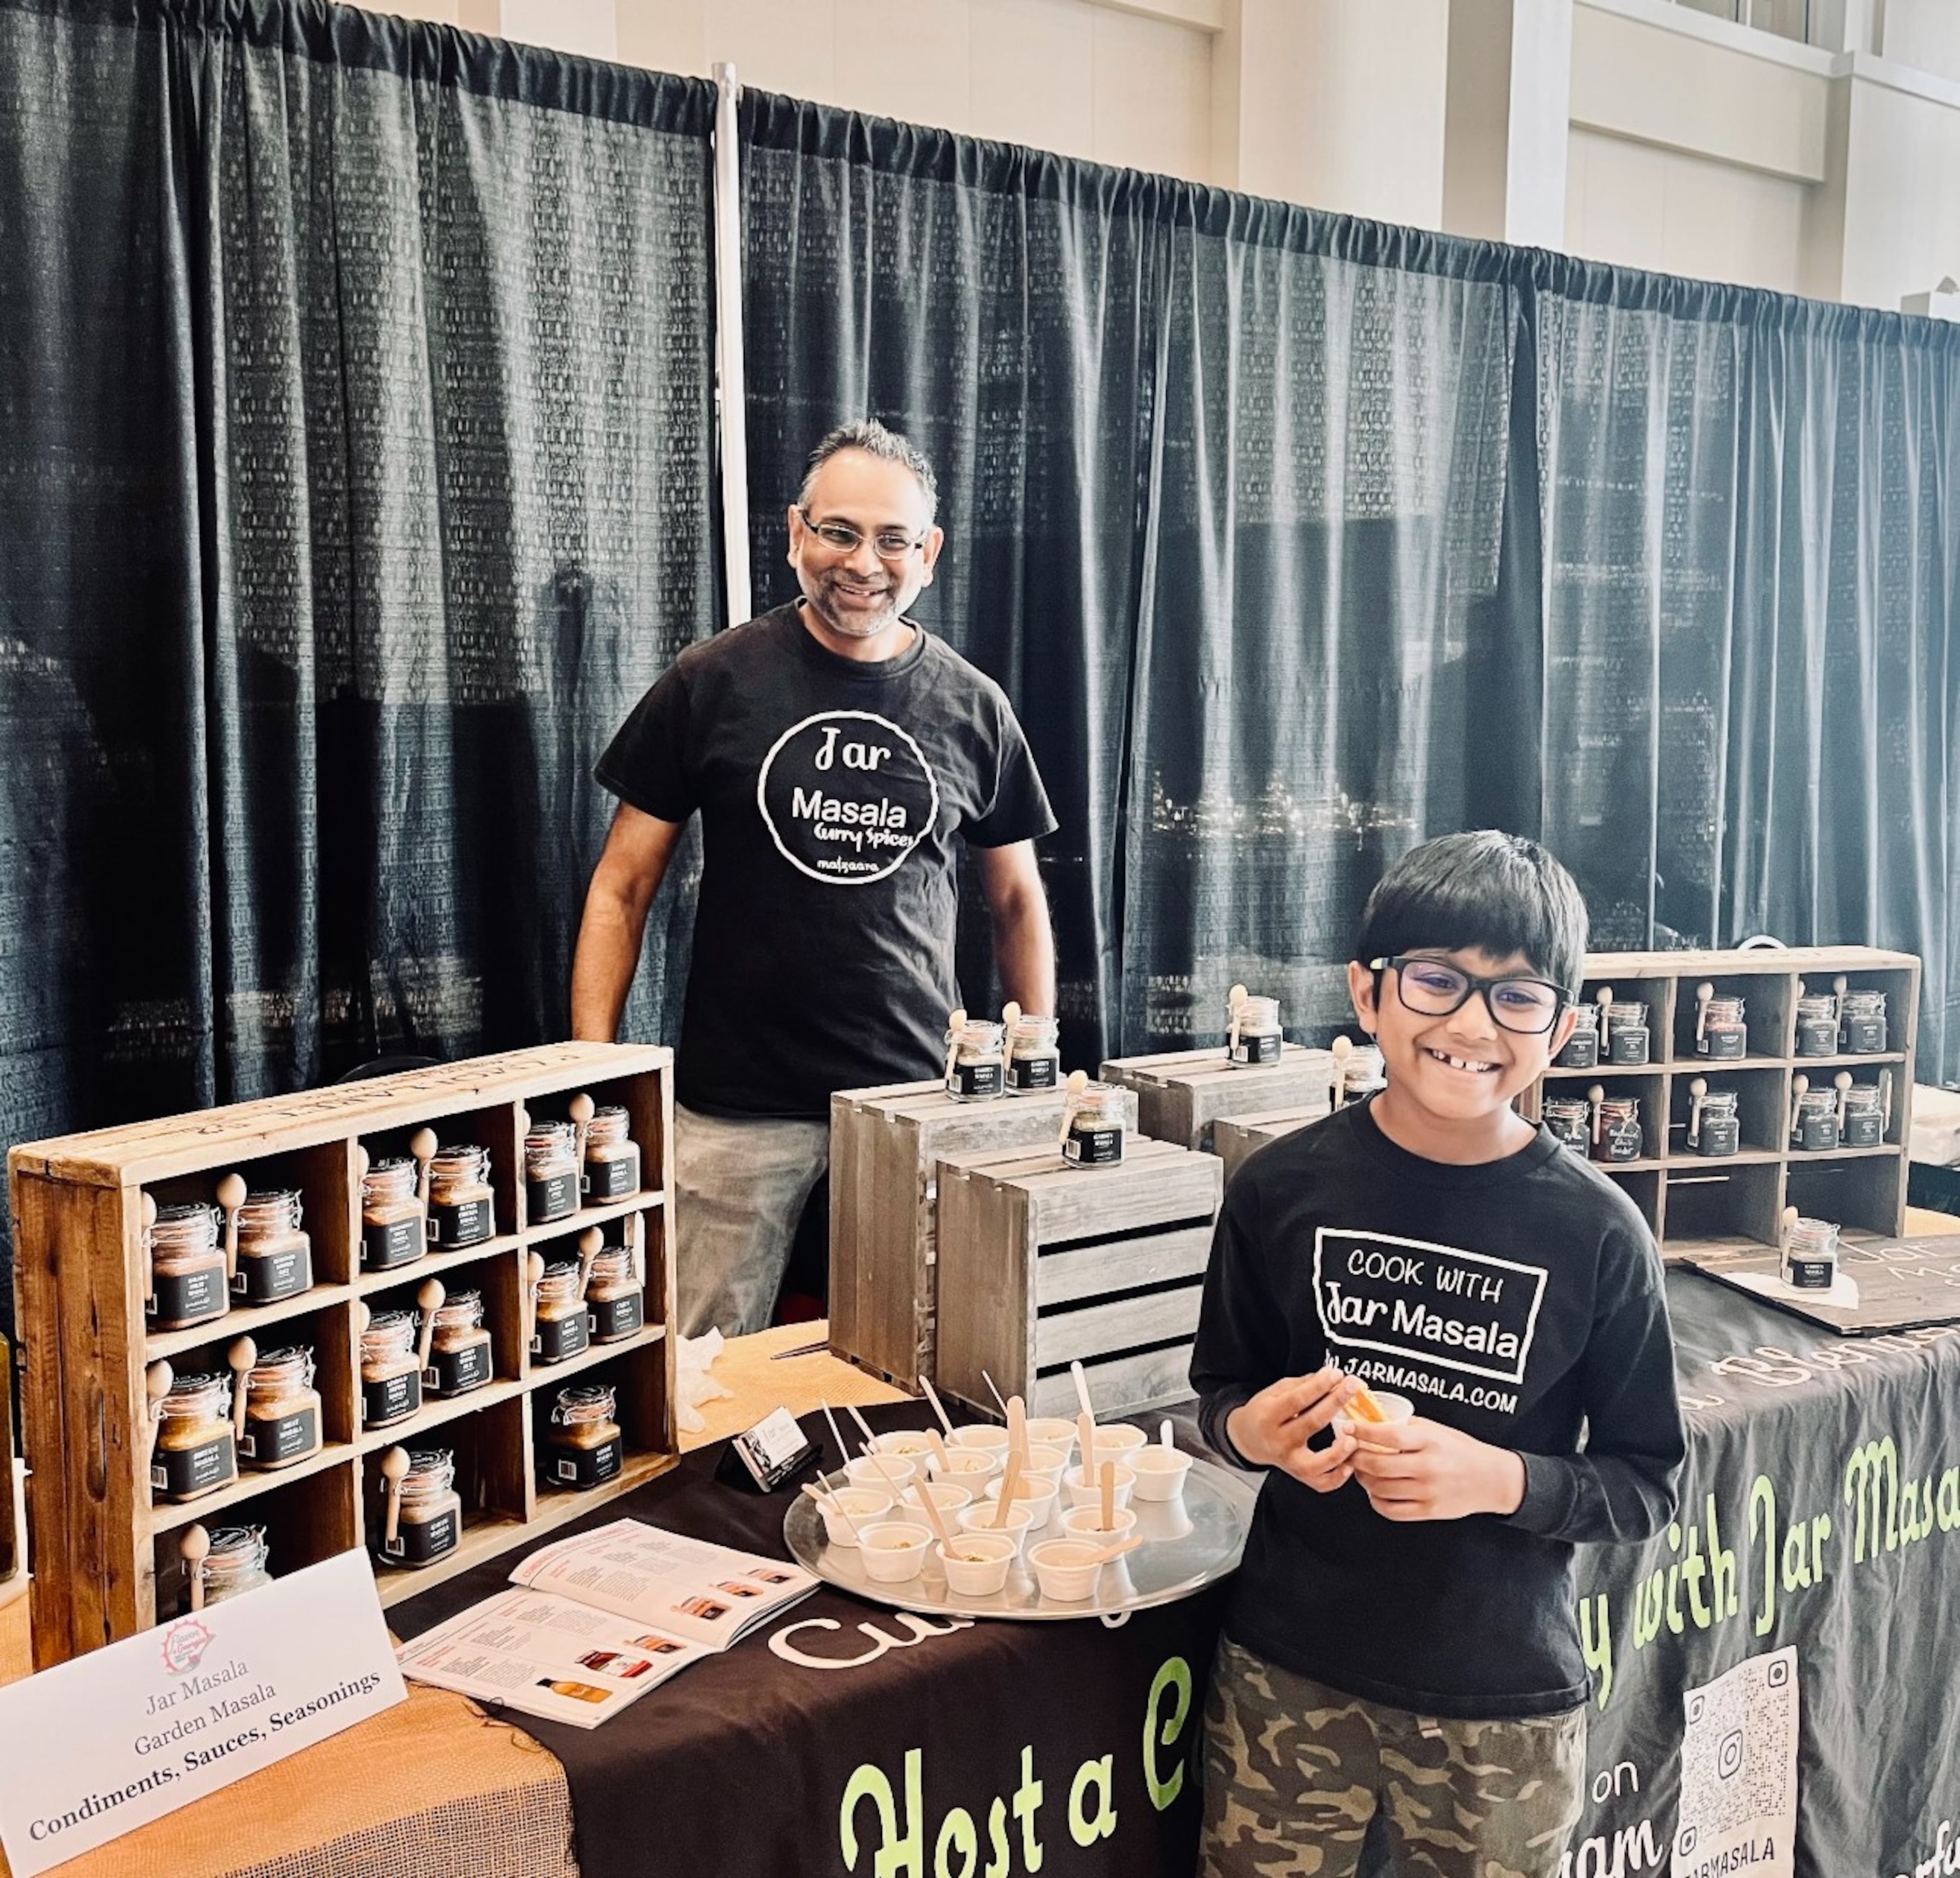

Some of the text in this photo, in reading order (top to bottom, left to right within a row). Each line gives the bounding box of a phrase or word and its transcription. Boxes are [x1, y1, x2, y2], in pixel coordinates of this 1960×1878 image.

[815, 727, 891, 770] Jar
[792, 787, 907, 828] Masala
[814, 822, 863, 852] Curry
[1348, 1249, 1504, 1304] COOK WITH
[1326, 1281, 1519, 1359] Jar Masala
[839, 1745, 1044, 1878] Host
[1068, 1754, 1117, 1847] a
[1633, 1493, 1737, 1650] with
[1749, 1474, 1832, 1638] Jar
[1844, 1435, 1960, 1565] Masa
[145, 1660, 250, 1717] Jar Masala
[134, 1682, 277, 1757] Garden Masala
[29, 1670, 382, 1841] Condiments, Sauces, Seasonings
[1592, 1761, 1639, 1803] on
[1684, 1837, 1775, 1878] ARMASALA
